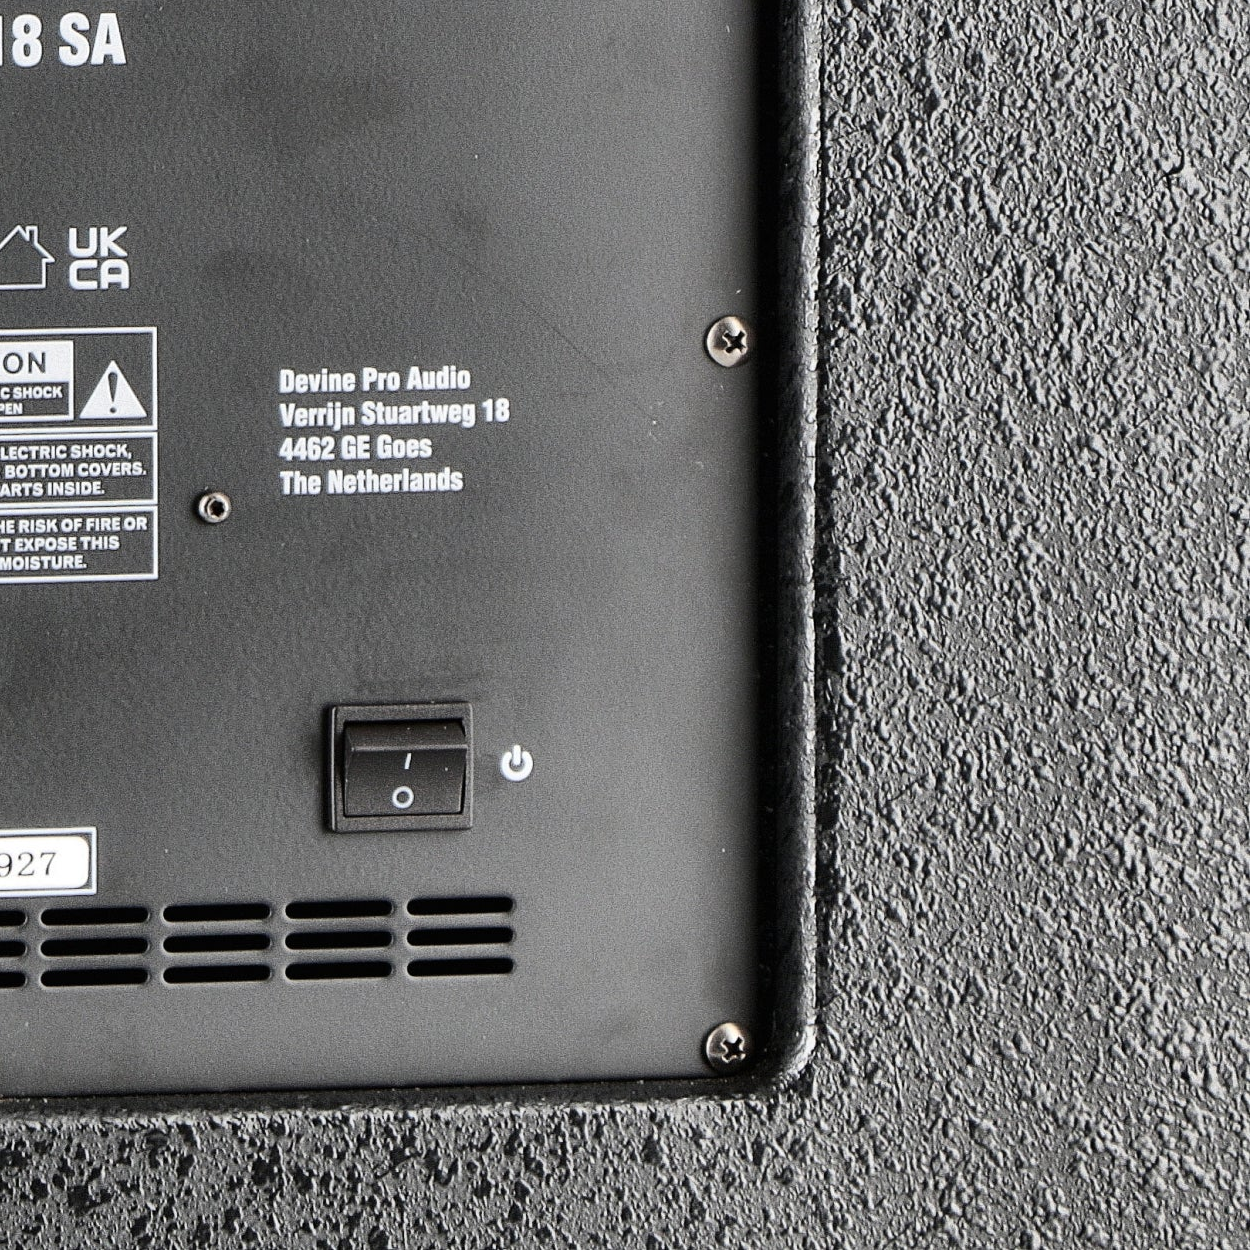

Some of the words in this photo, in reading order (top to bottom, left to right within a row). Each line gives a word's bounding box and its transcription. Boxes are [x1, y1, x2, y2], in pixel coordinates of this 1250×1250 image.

[59, 12, 126, 66] SA
[280, 368, 355, 393] Devine
[363, 367, 400, 391] Pro
[407, 365, 470, 390] Audio
[13, 386, 62, 399] SHOCK
[279, 402, 355, 431] Verrijn
[361, 401, 475, 428] Stuartweg
[482, 398, 509, 422] 18
[71, 444, 131, 459] SHOCK,
[279, 436, 335, 461] 4462
[341, 435, 370, 459] GE
[377, 434, 432, 459] Goes
[5, 463, 73, 479] BOTTOM
[78, 462, 146, 477] COVERS.
[48, 481, 104, 495] INSIDE.
[280, 471, 321, 494] The
[328, 467, 463, 494] Netherlands
[19, 519, 58, 533] RISK
[61, 518, 82, 532] OF
[86, 517, 120, 531] FIRE
[123, 516, 147, 530] OR
[15, 537, 77, 552] EXPOSE
[80, 535, 119, 550] THIS
[0, 555, 86, 570] MOISTURE.
